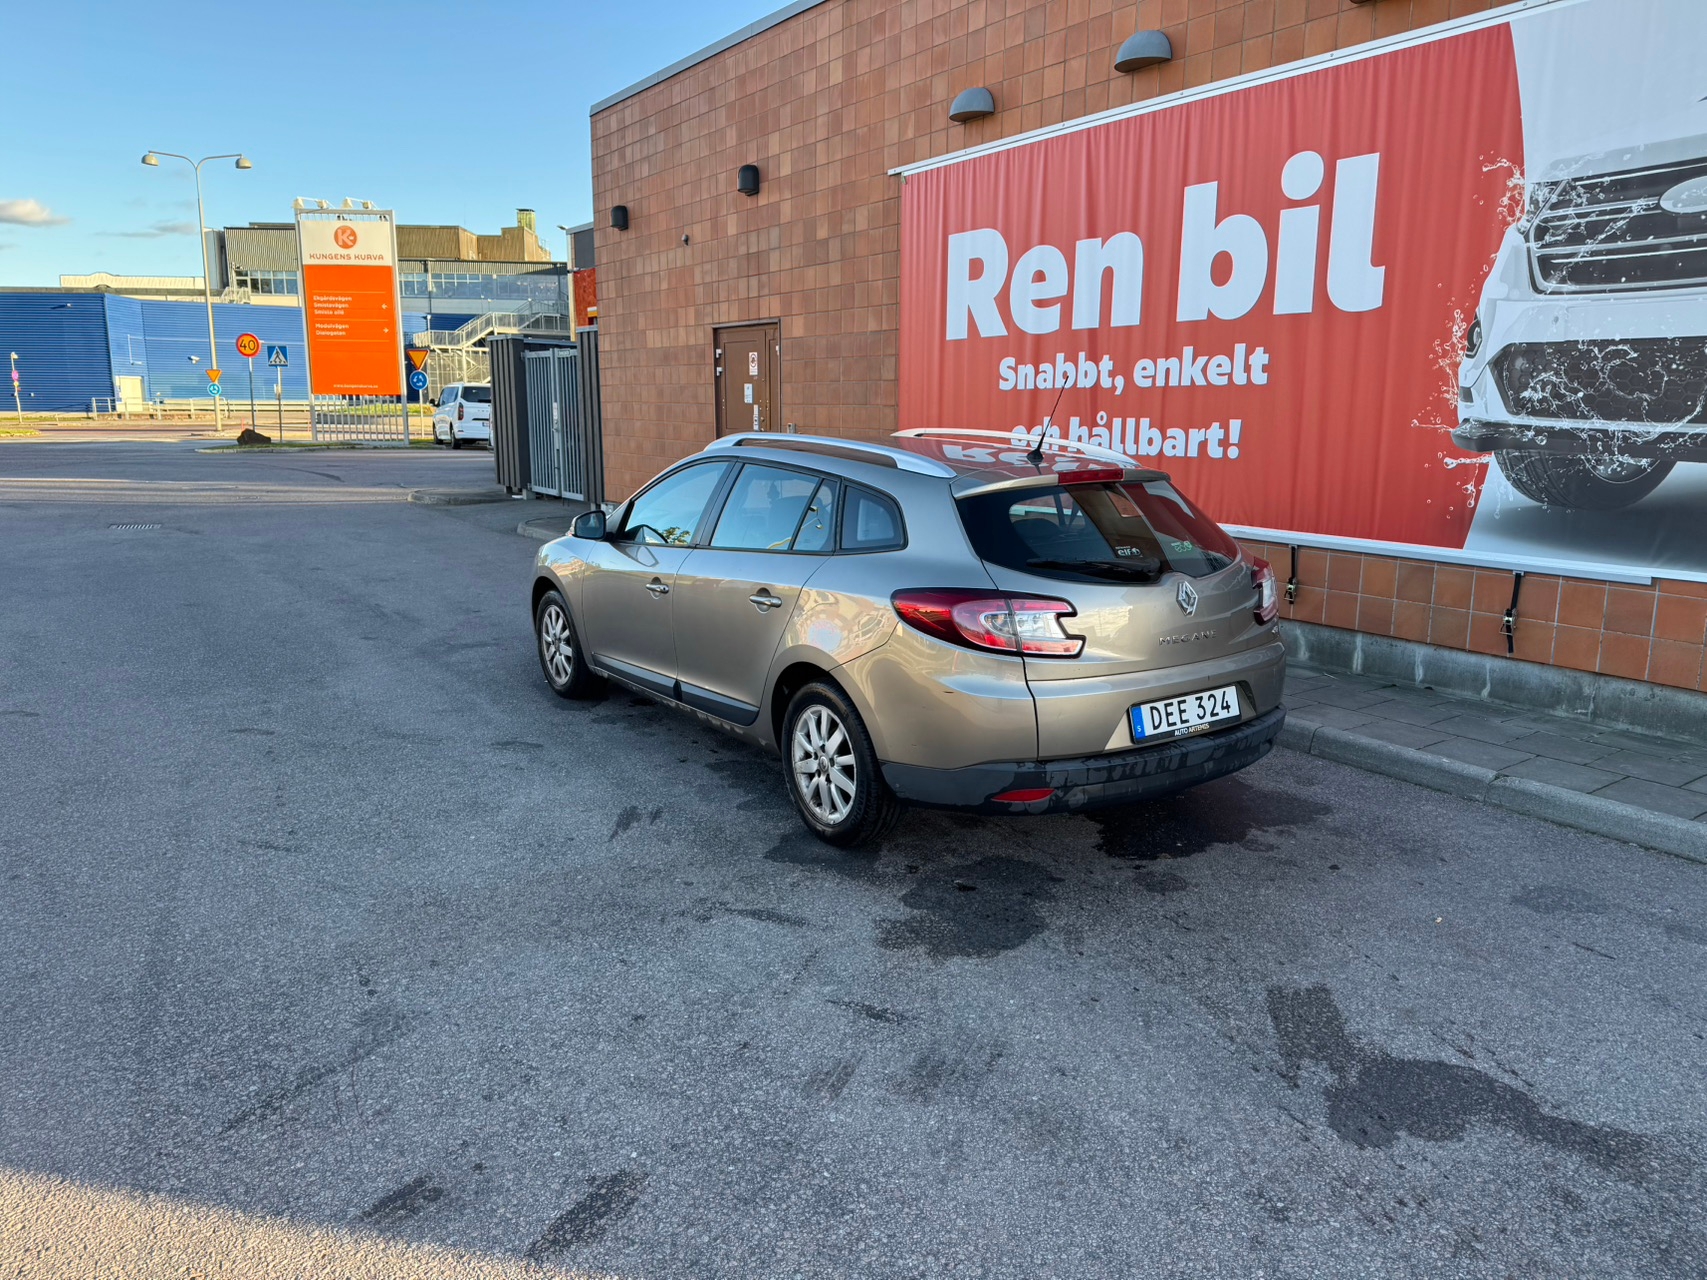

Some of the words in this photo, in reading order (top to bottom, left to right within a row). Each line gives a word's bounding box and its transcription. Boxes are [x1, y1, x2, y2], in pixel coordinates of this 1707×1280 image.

[946, 228, 1144, 341] Ren
[1176, 150, 1386, 323] bil
[309, 253, 352, 261] KUNGENS
[354, 253, 384, 261] KURVA
[240, 339, 256, 351] 40
[999, 352, 1125, 395] Snabbt,
[1133, 343, 1270, 387] enkelt
[1068, 411, 1242, 459] hållbart!
[1117, 548, 1132, 557] elf
[1158, 629, 1217, 646] MEGANE
[1149, 699, 1190, 731] DEE
[1195, 691, 1231, 721] 324
[1174, 728, 1188, 737] AUTO
[1188, 723, 1210, 734] ARTEMIS
